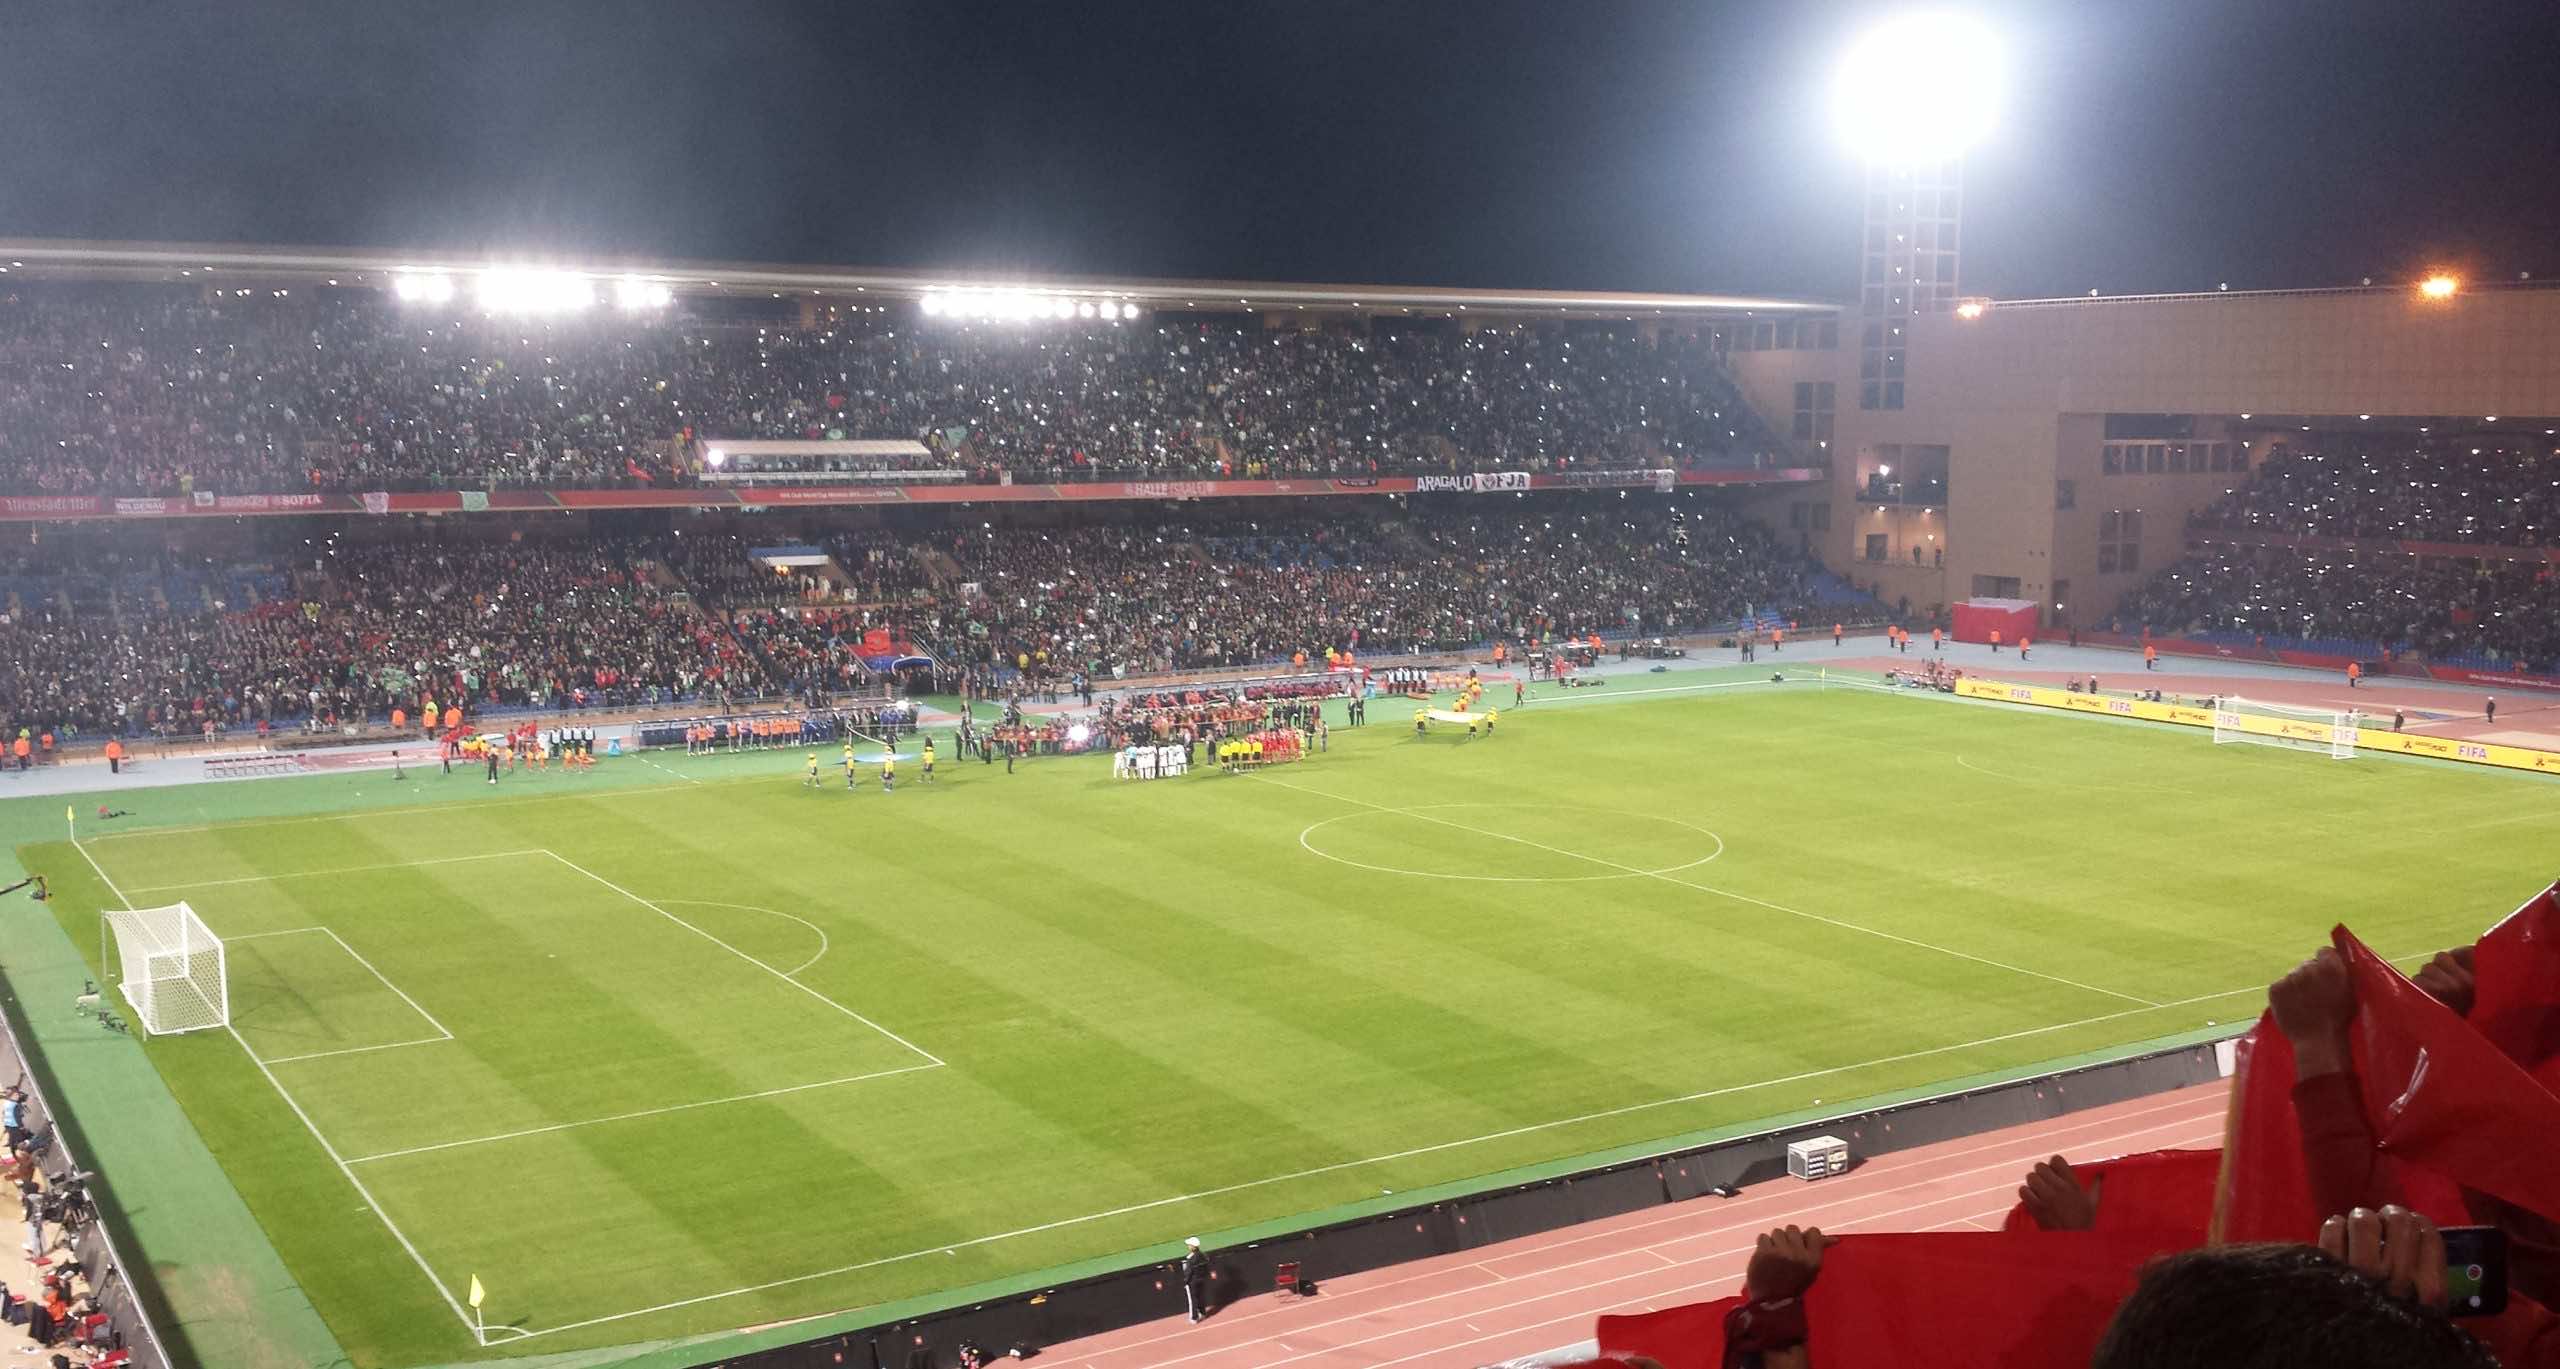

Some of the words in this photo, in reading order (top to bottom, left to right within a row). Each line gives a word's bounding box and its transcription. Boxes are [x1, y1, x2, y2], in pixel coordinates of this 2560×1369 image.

[1136, 483, 1168, 496] HALLE
[2011, 688, 2032, 699] FIFA
[2110, 701, 2131, 713] FIFA
[2458, 745, 2488, 760] FIFA
